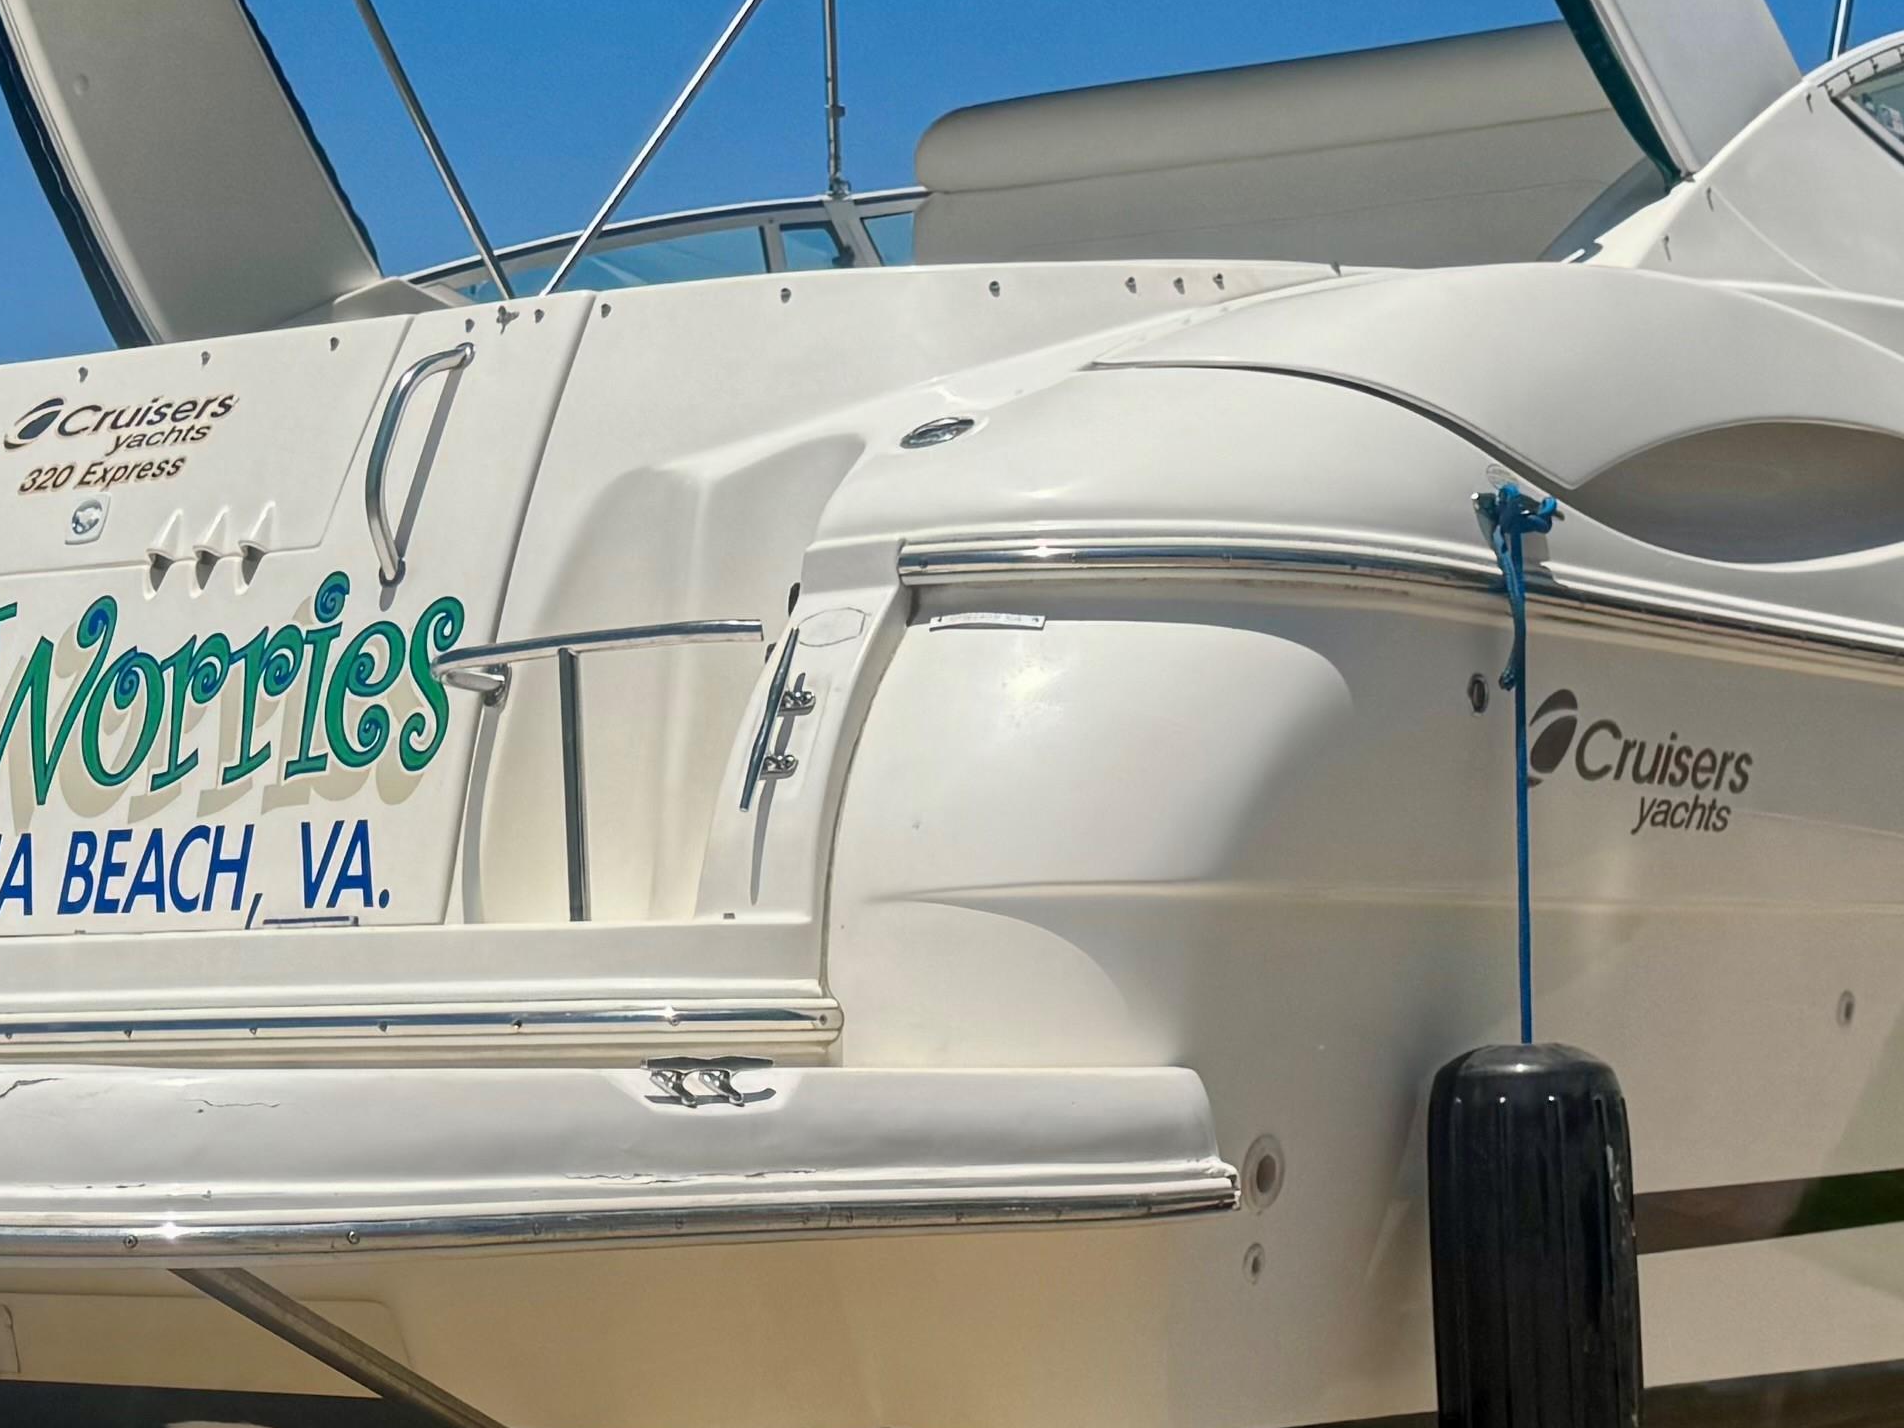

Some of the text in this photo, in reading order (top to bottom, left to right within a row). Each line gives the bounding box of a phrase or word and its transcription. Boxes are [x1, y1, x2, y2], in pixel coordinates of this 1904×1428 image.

[57, 394, 238, 437] Cruisers
[105, 424, 212, 457] yachts
[18, 456, 186, 493] 320 Express
[1574, 718, 1754, 795] Cruisers
[1630, 793, 1732, 836] yachts
[56, 823, 264, 930] BEACH,
[300, 819, 391, 910] VA.
